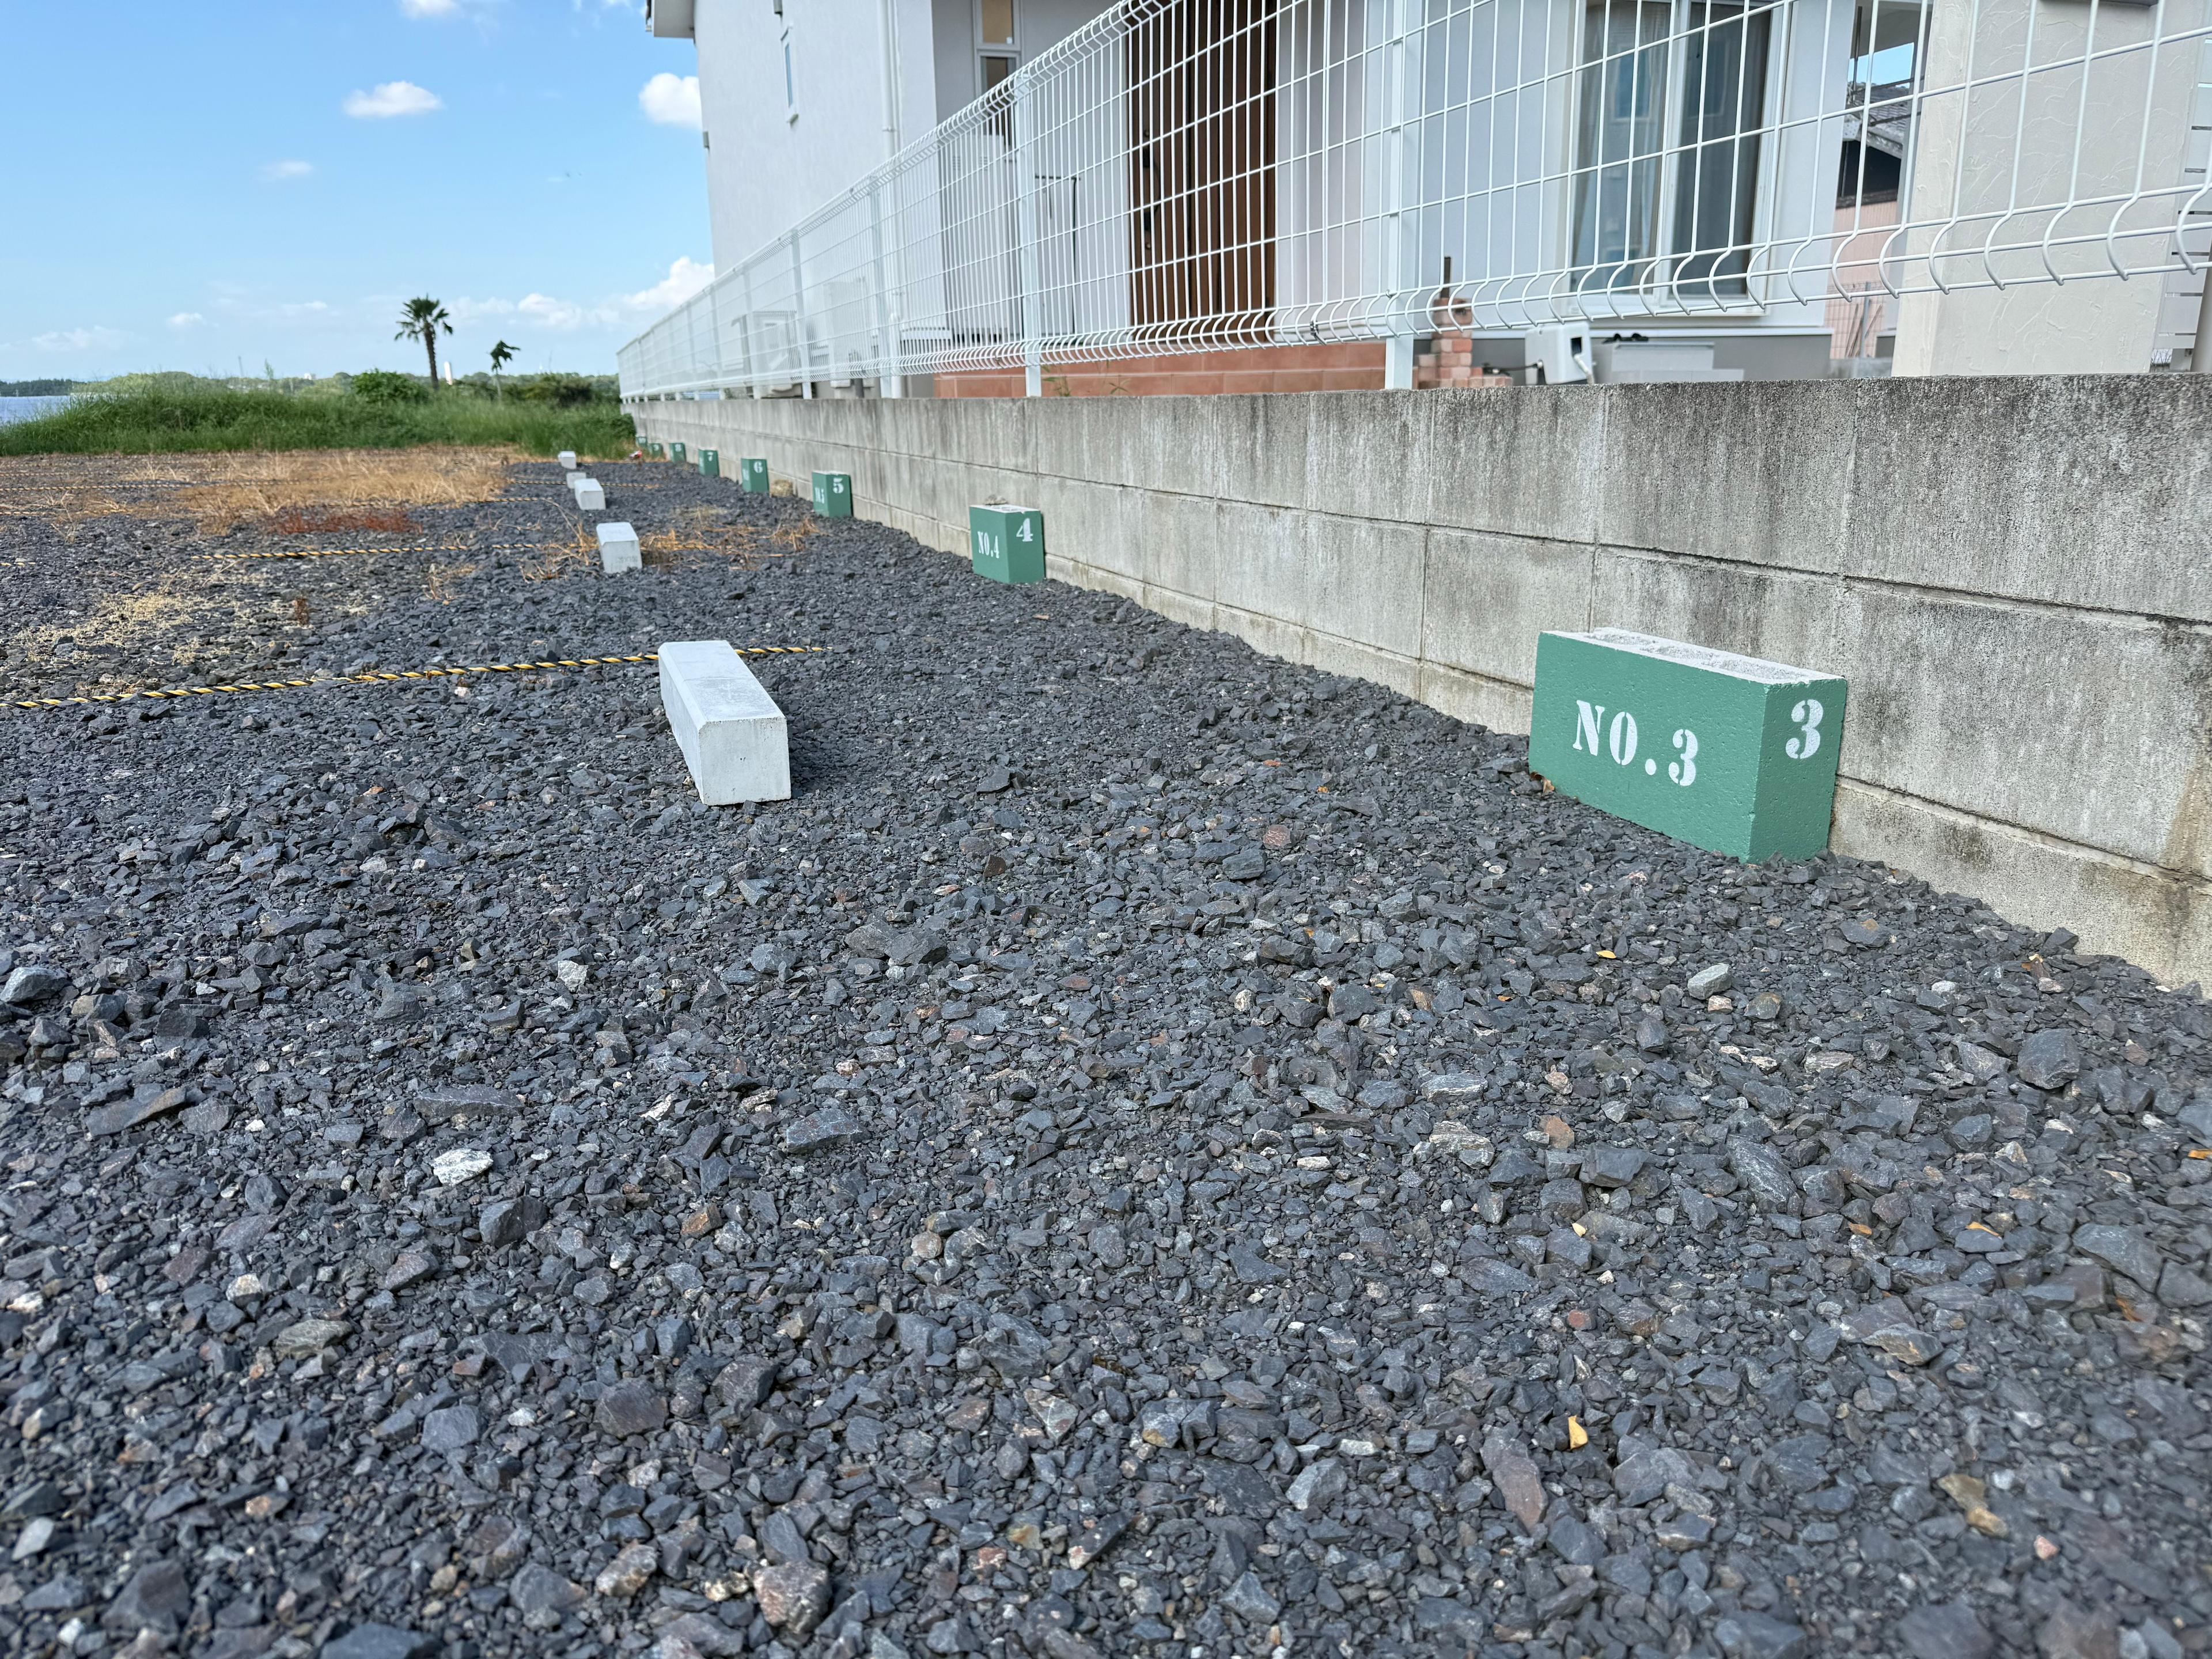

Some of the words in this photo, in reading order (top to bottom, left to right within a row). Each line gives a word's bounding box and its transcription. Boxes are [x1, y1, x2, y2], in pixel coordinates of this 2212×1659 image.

[707, 452, 714, 461] 7
[753, 461, 763, 473] 6
[833, 478, 844, 494] 5
[1016, 518, 1033, 542] 4
[977, 531, 999, 559] NO.4
[1786, 699, 1823, 759] 3
[1573, 700, 1698, 786] NO.3
